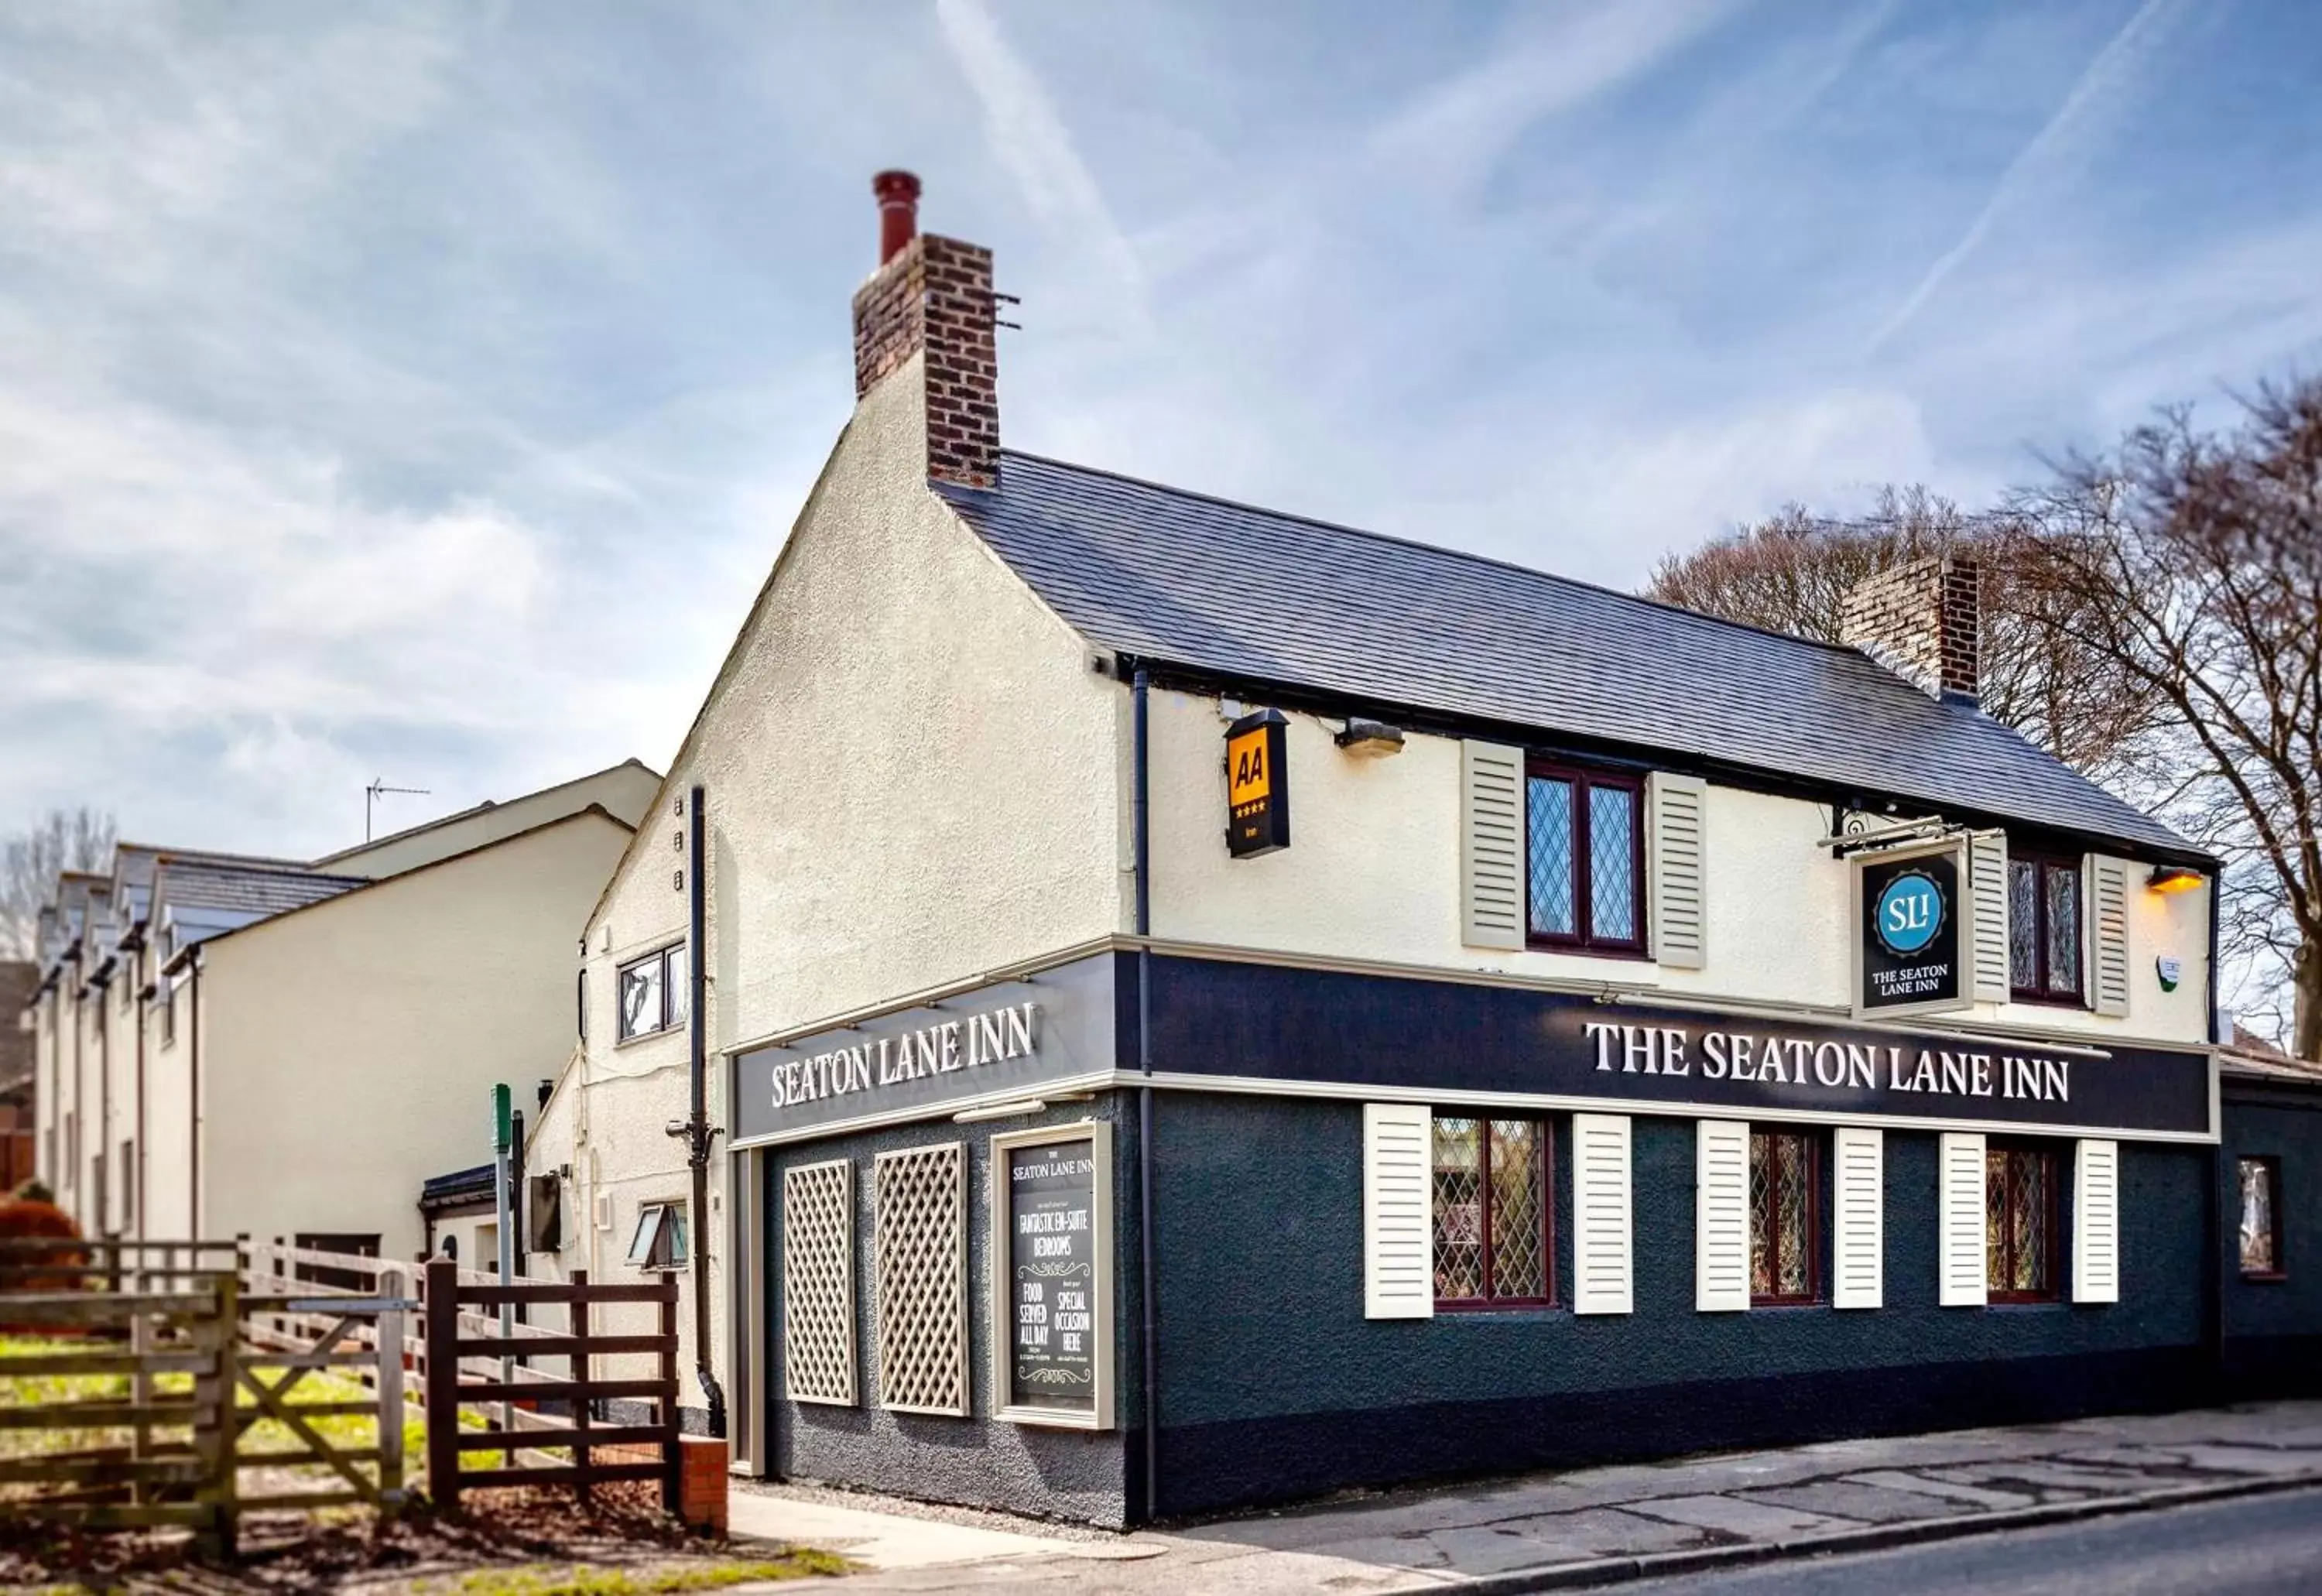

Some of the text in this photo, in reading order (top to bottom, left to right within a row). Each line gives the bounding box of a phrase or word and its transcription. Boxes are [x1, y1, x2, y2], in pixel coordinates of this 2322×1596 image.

[1235, 745, 1262, 789] AA
[1872, 964, 1948, 985] THE SEATON
[1881, 978, 1939, 997] LANE INN
[772, 1002, 1036, 1108] SEATON LANE INN
[1584, 1022, 2070, 1103] THE SEATON LANE INN
[1013, 1163, 1049, 1181] SEATON
[1050, 1160, 1075, 1176] LANE
[1033, 1235, 1071, 1257] BEDROOMS
[1022, 1283, 1043, 1303] FOOD
[1058, 1291, 1086, 1310] SPECIAL
[1019, 1303, 1047, 1324] SERVED
[1055, 1312, 1090, 1331] OCCASION
[1020, 1324, 1049, 1346] ALL DAY
[1063, 1333, 1081, 1352] HERE
